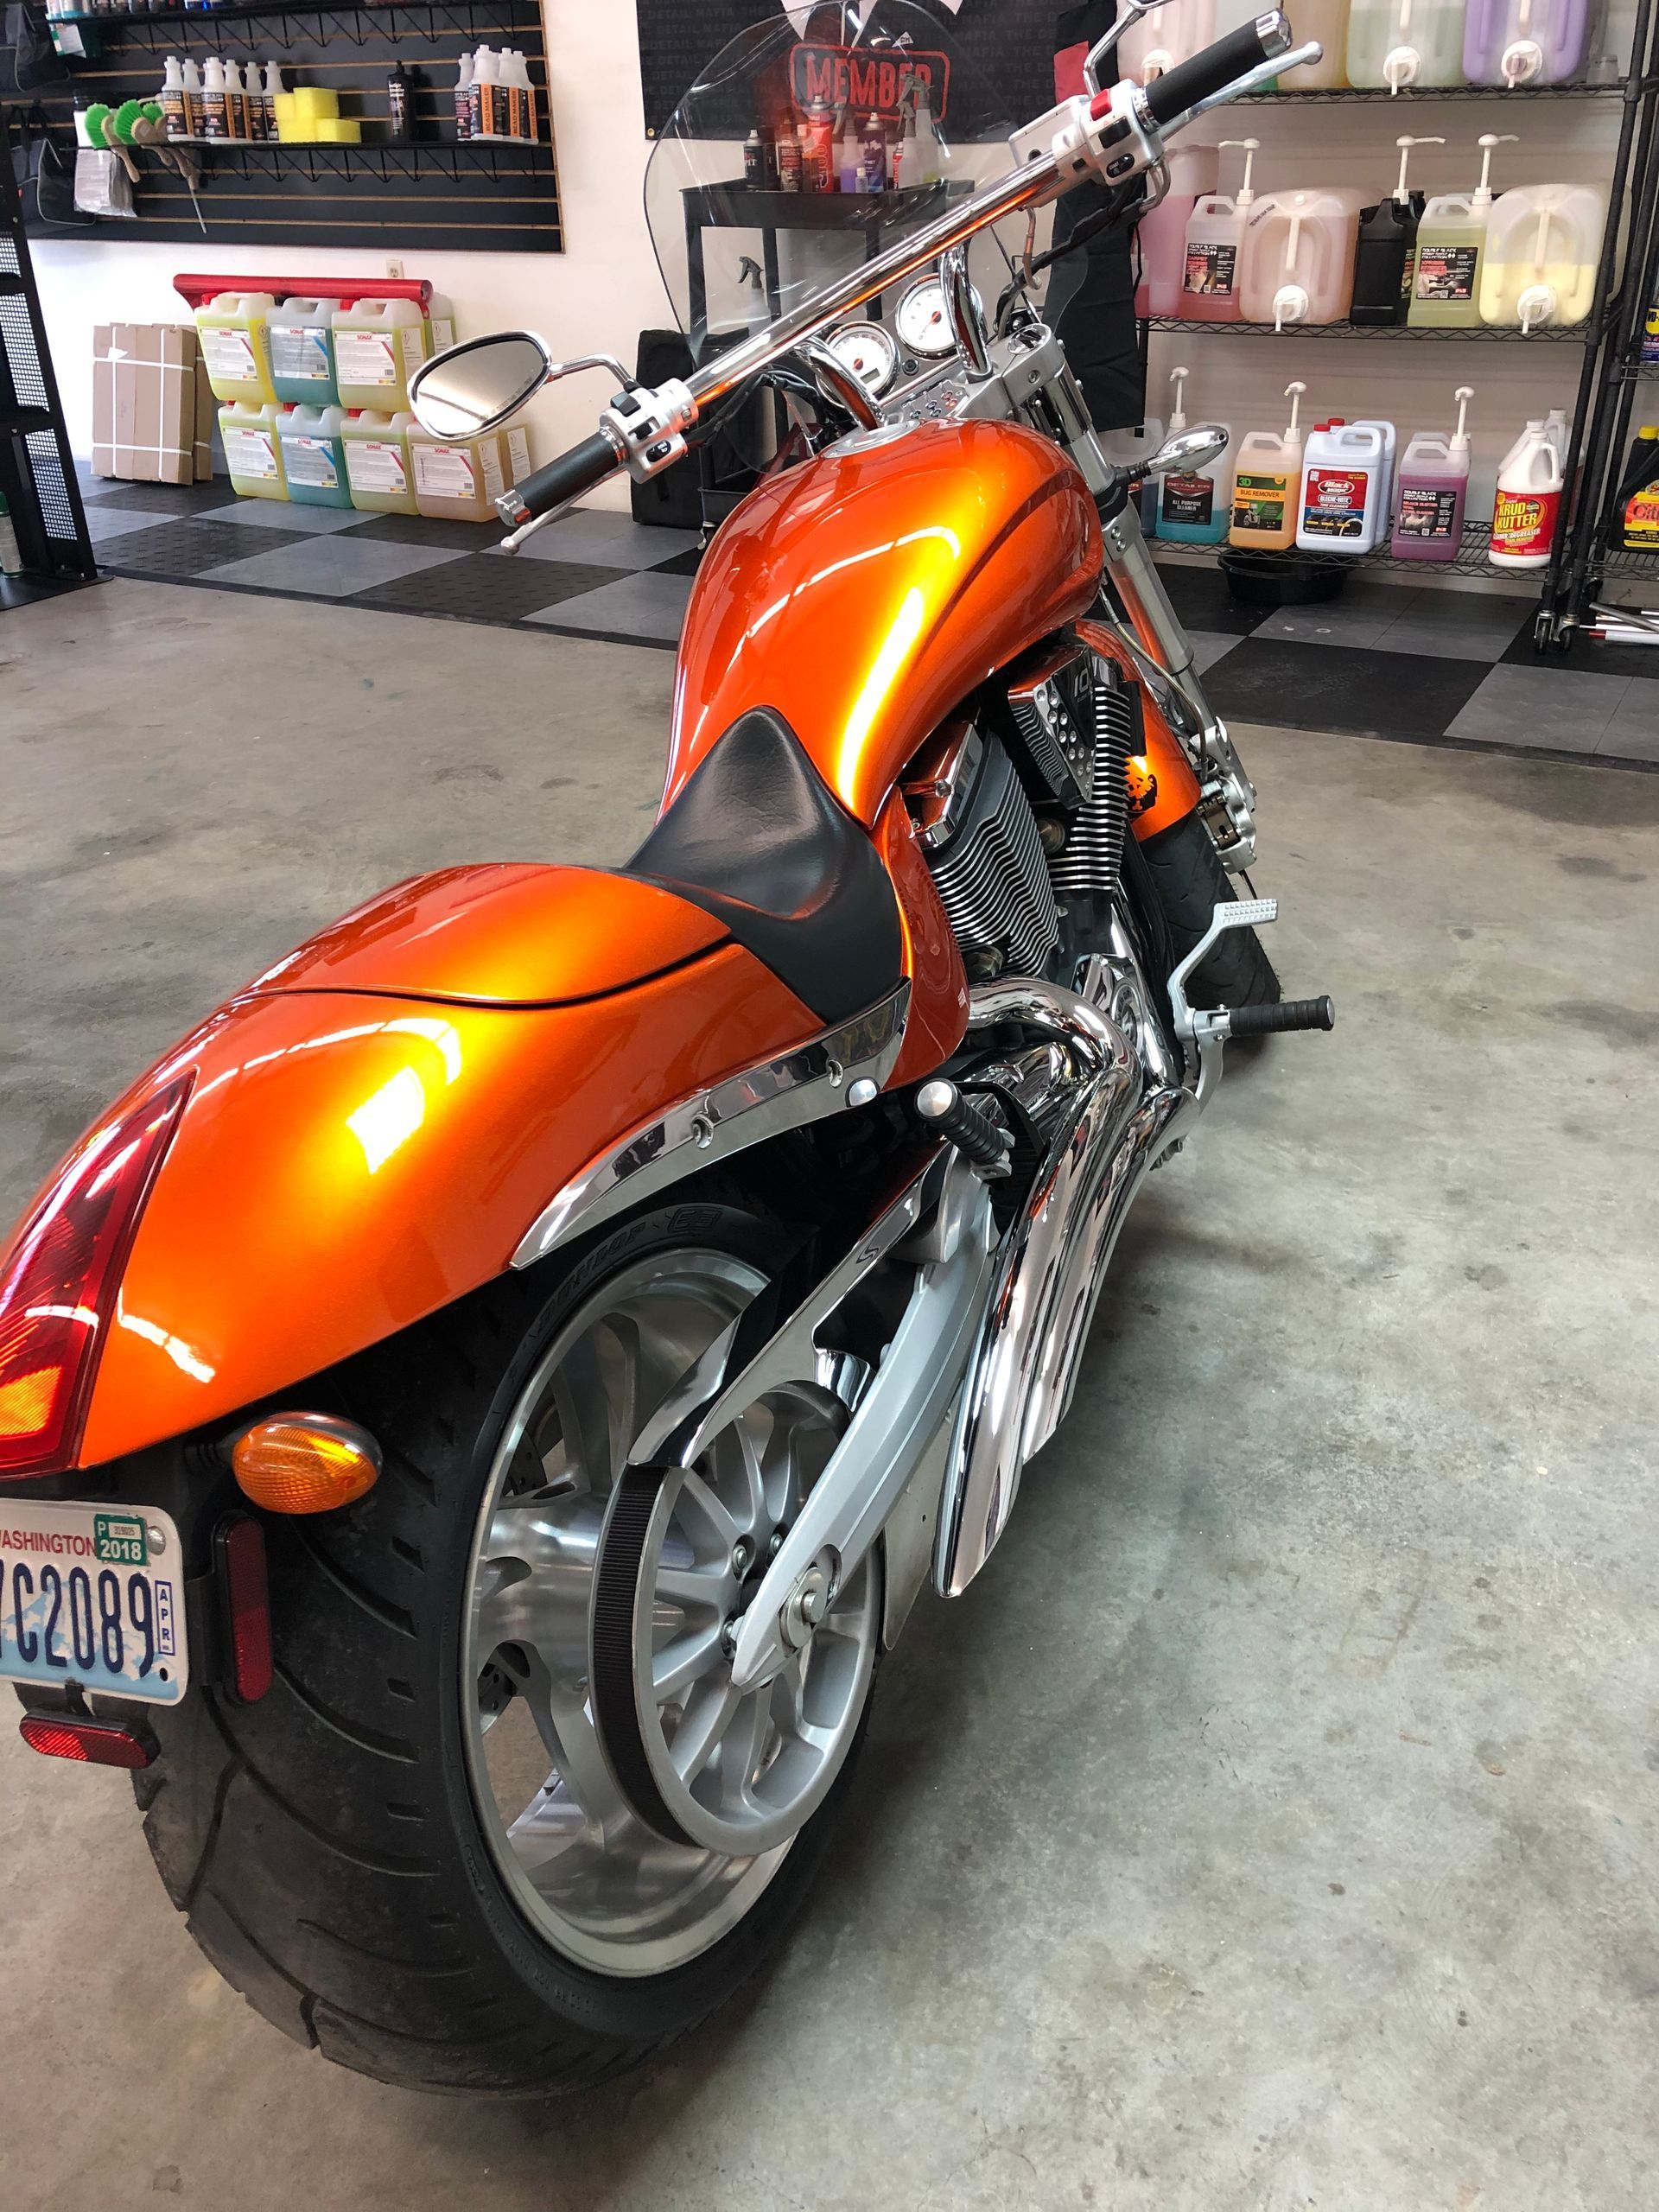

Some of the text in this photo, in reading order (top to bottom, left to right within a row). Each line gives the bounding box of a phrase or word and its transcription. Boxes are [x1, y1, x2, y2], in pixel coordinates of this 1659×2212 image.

[804, 53, 934, 110] MEMBER
[1237, 476, 1252, 486] 3D
[1498, 502, 1526, 517] KRUD
[1497, 512, 1538, 529] KUTTER
[97, 1521, 107, 1537] P
[0, 1529, 97, 1557] ASHINGTON
[99, 1538, 143, 1561] 2018
[0, 1558, 154, 1679] C2089
